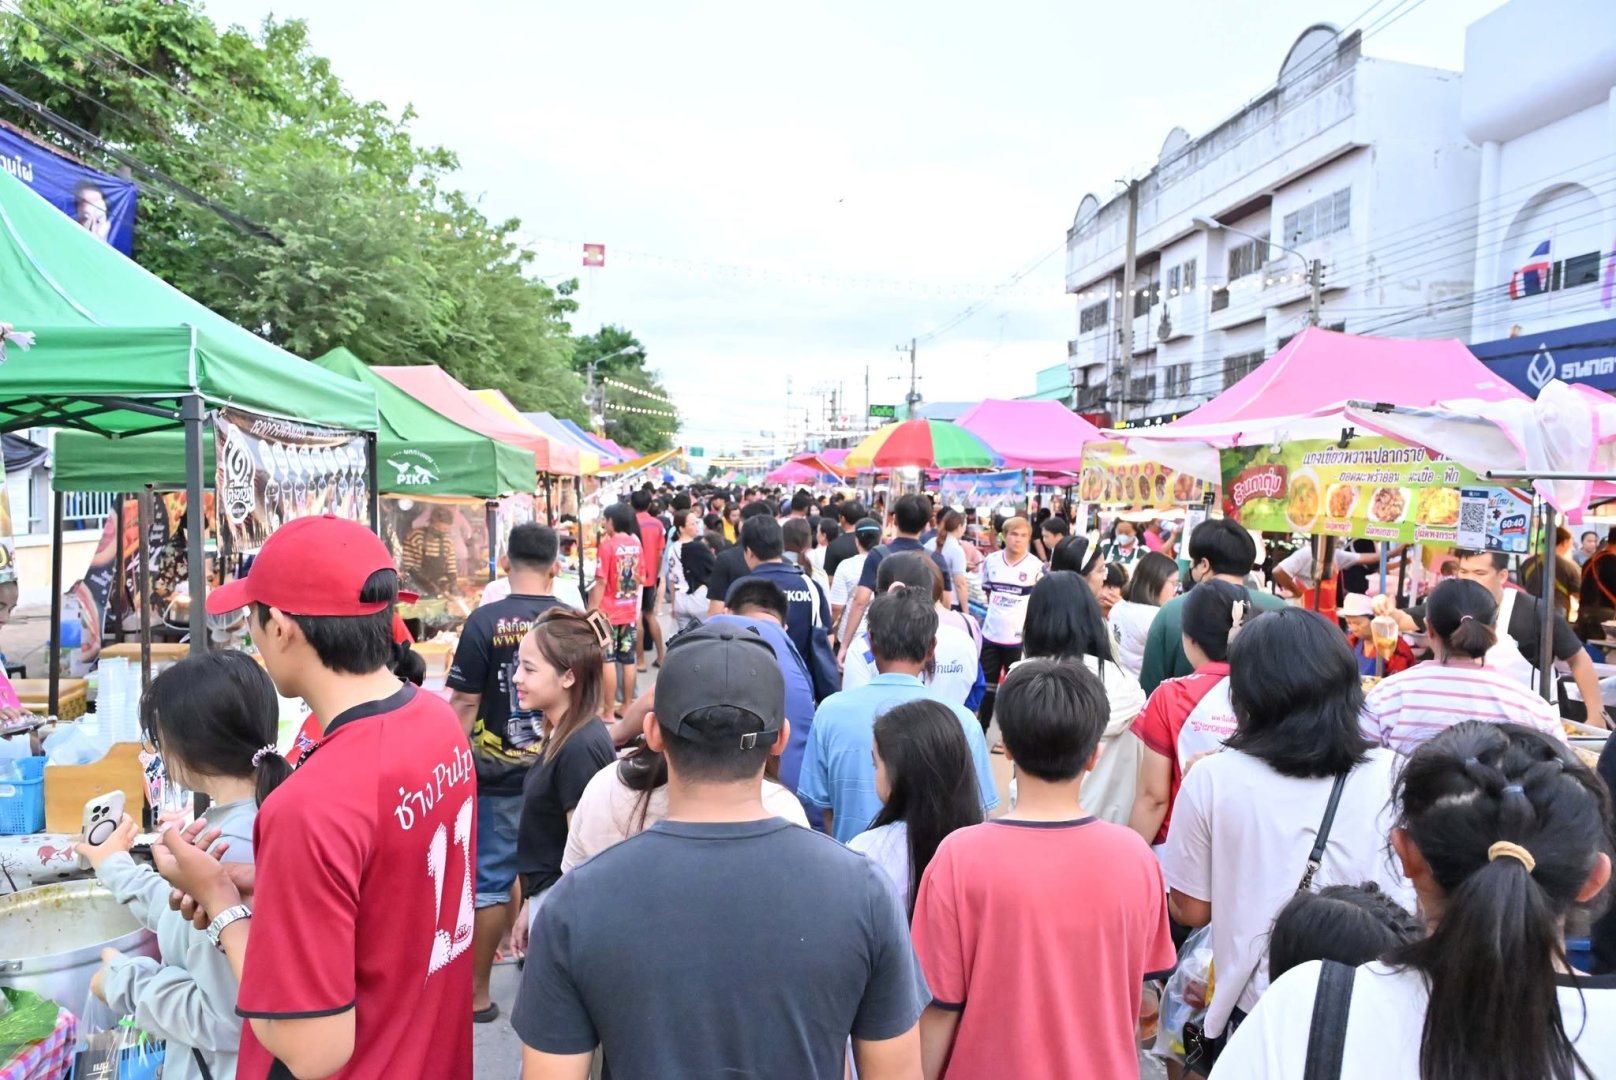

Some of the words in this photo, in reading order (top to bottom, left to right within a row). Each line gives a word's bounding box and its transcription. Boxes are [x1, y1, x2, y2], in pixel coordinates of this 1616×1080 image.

[1561, 356, 1616, 380] ธนาค
[397, 473, 431, 485] PIKA
[1502, 517, 1524, 529] 60:40
[783, 590, 812, 601] KOK
[394, 782, 434, 830] ช่าง
[432, 745, 473, 803] Pulp
